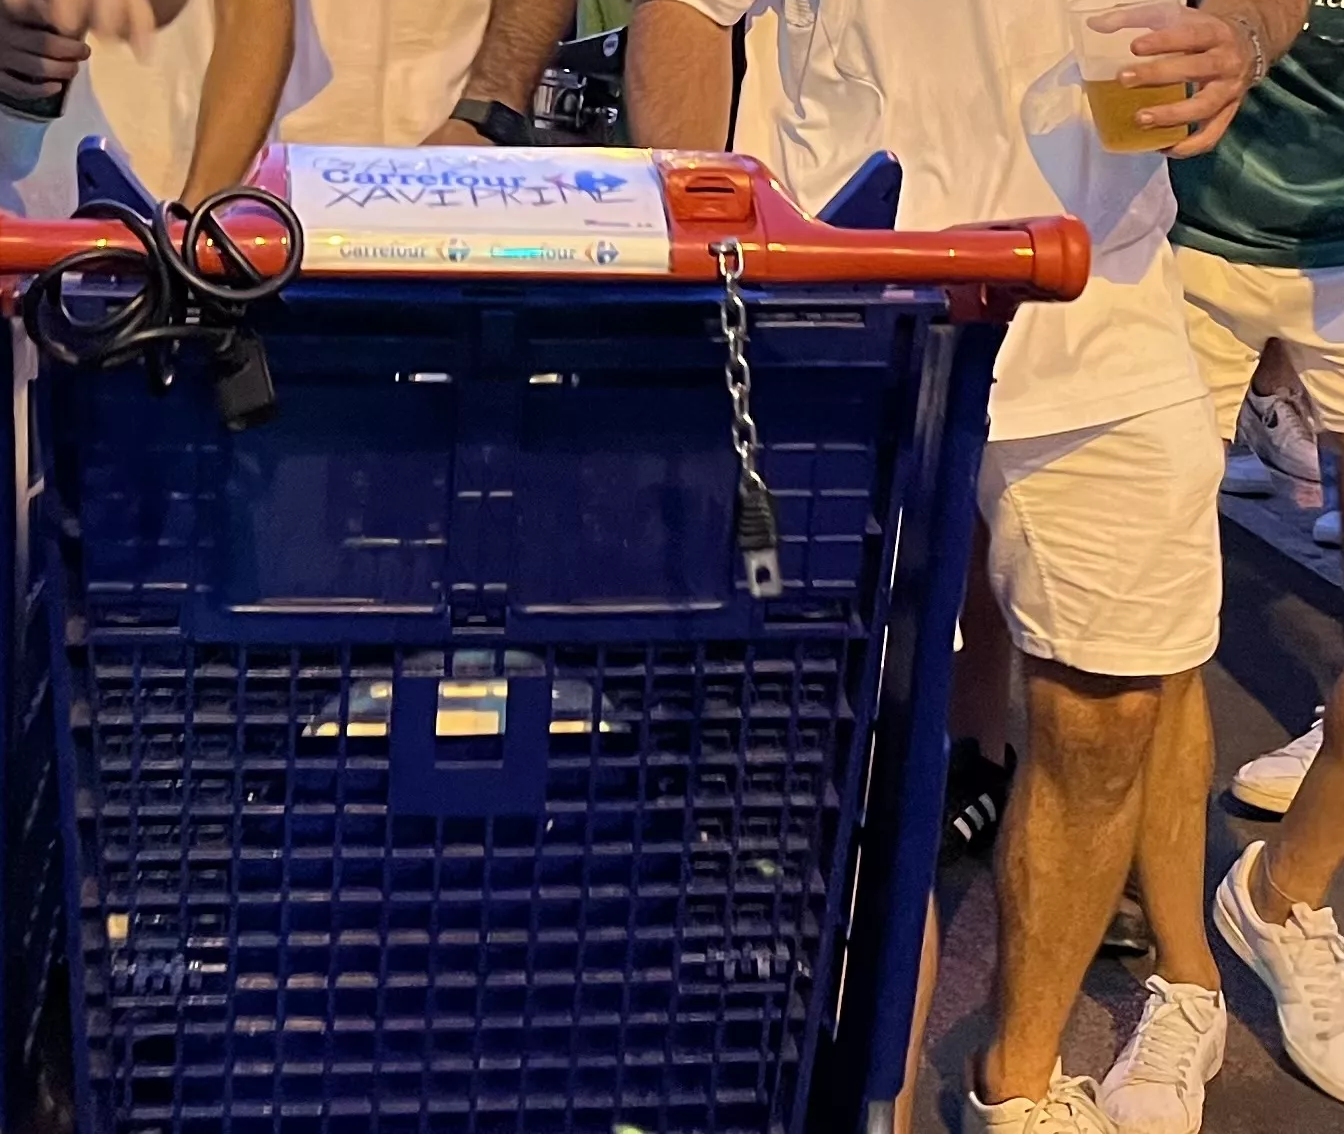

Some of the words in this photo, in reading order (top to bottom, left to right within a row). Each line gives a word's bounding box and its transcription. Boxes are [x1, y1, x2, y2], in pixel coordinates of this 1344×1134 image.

[322, 168, 526, 188] Carrefour
[339, 241, 425, 259] Carrefour
[490, 242, 577, 260] Cfour
